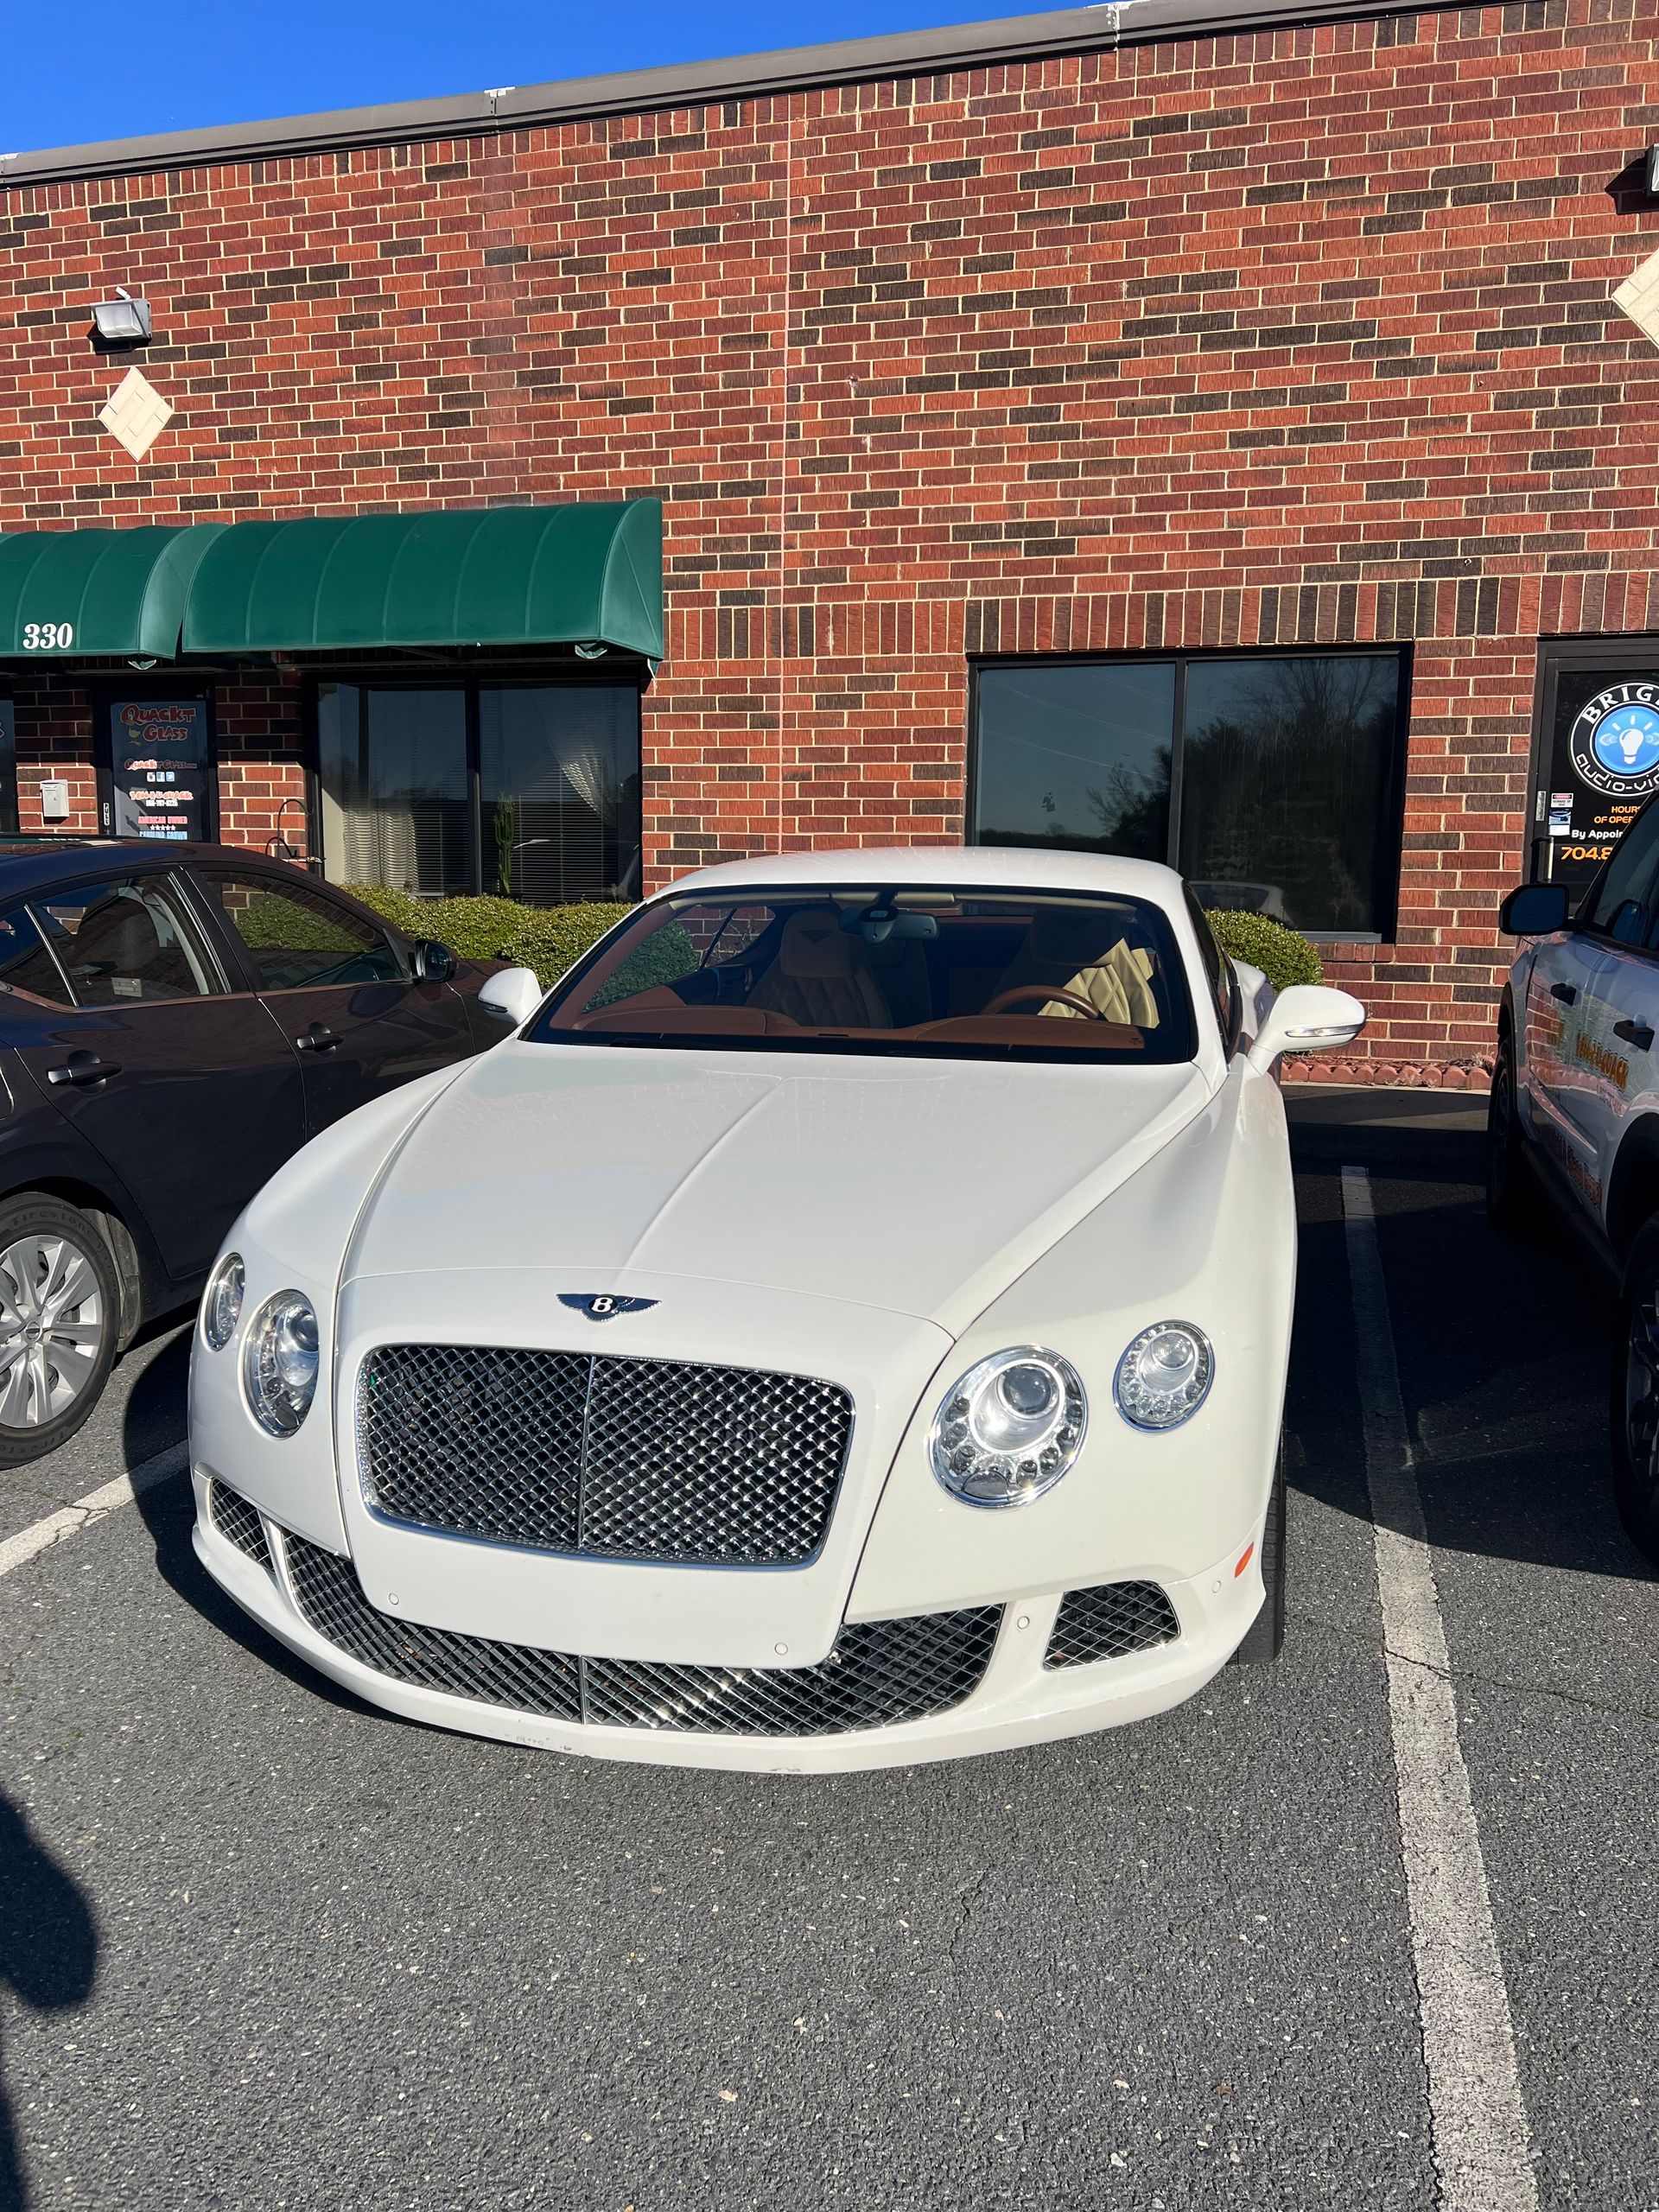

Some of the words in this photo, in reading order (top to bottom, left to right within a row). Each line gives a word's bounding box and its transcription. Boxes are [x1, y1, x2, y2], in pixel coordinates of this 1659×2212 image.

[22, 622, 73, 650] 330
[1581, 685, 1659, 725] BRIG
[1572, 830, 1586, 840] By
[1560, 846, 1613, 861] 704.8
